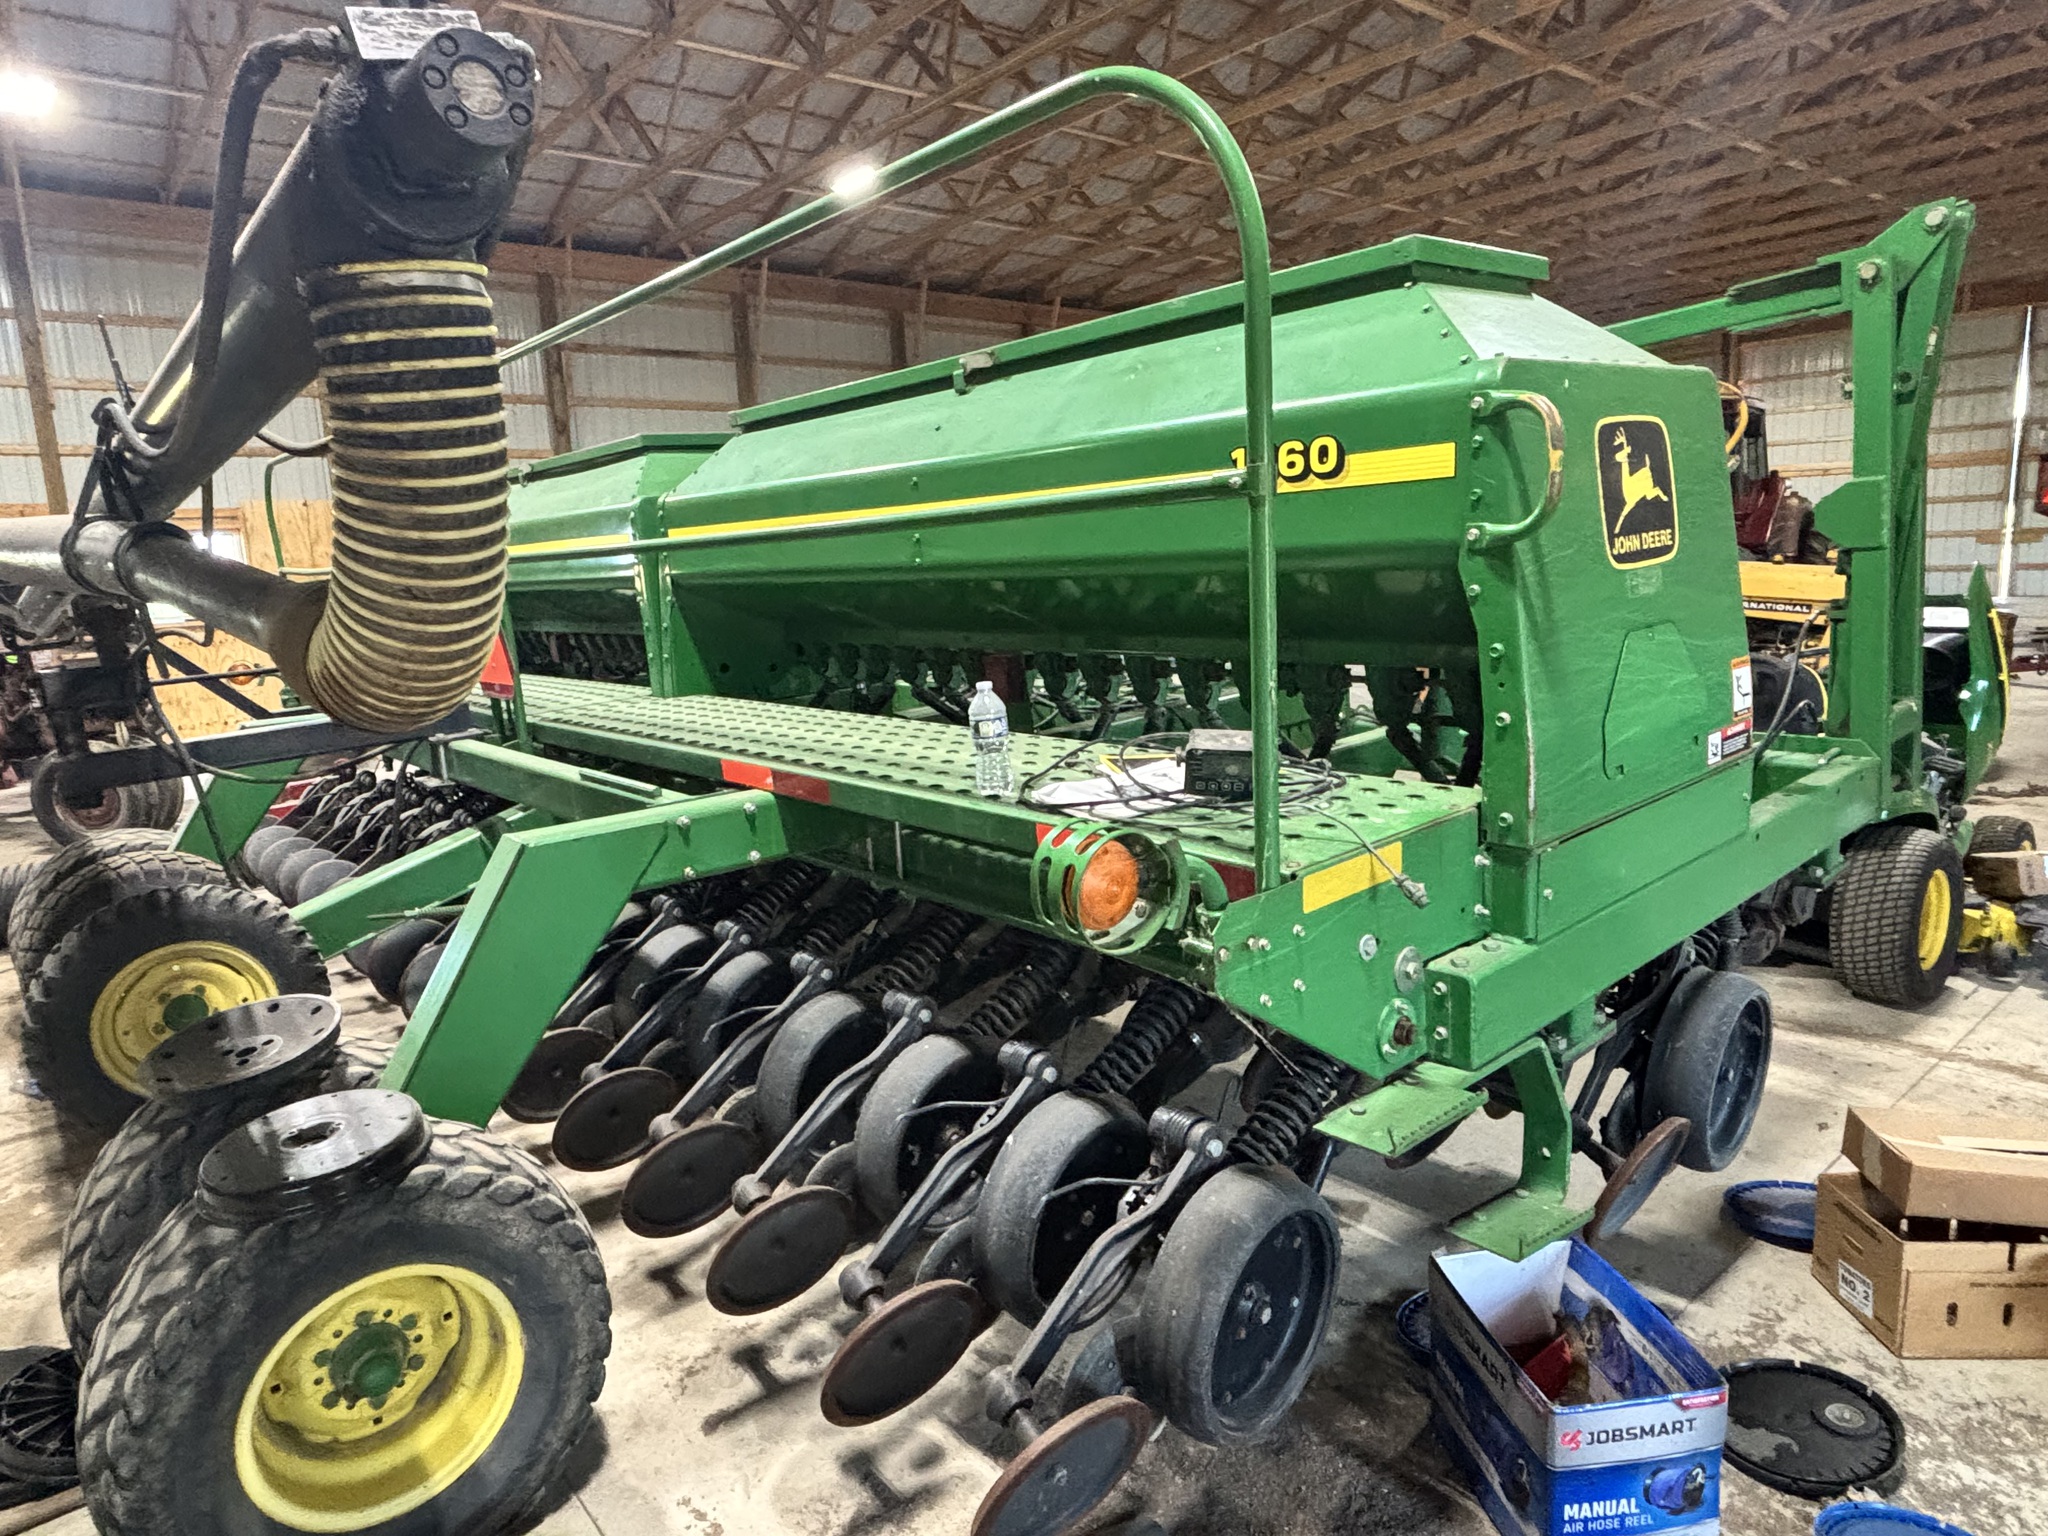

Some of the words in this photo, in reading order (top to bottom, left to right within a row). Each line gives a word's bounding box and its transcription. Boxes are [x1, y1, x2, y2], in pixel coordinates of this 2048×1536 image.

[1230, 435, 1344, 482] 160
[1612, 534, 1641, 555] JOHN
[1642, 529, 1673, 550] DEERE
[1743, 601, 1810, 613] RNATIONAL
[1862, 1289, 1871, 1303] 2
[1586, 1418, 1698, 1446] JOBSMART
[1563, 1497, 1641, 1521] MANUAL
[1563, 1521, 1584, 1534] AIR
[1588, 1518, 1621, 1531] HOSE
[1625, 1514, 1654, 1527] REEL
